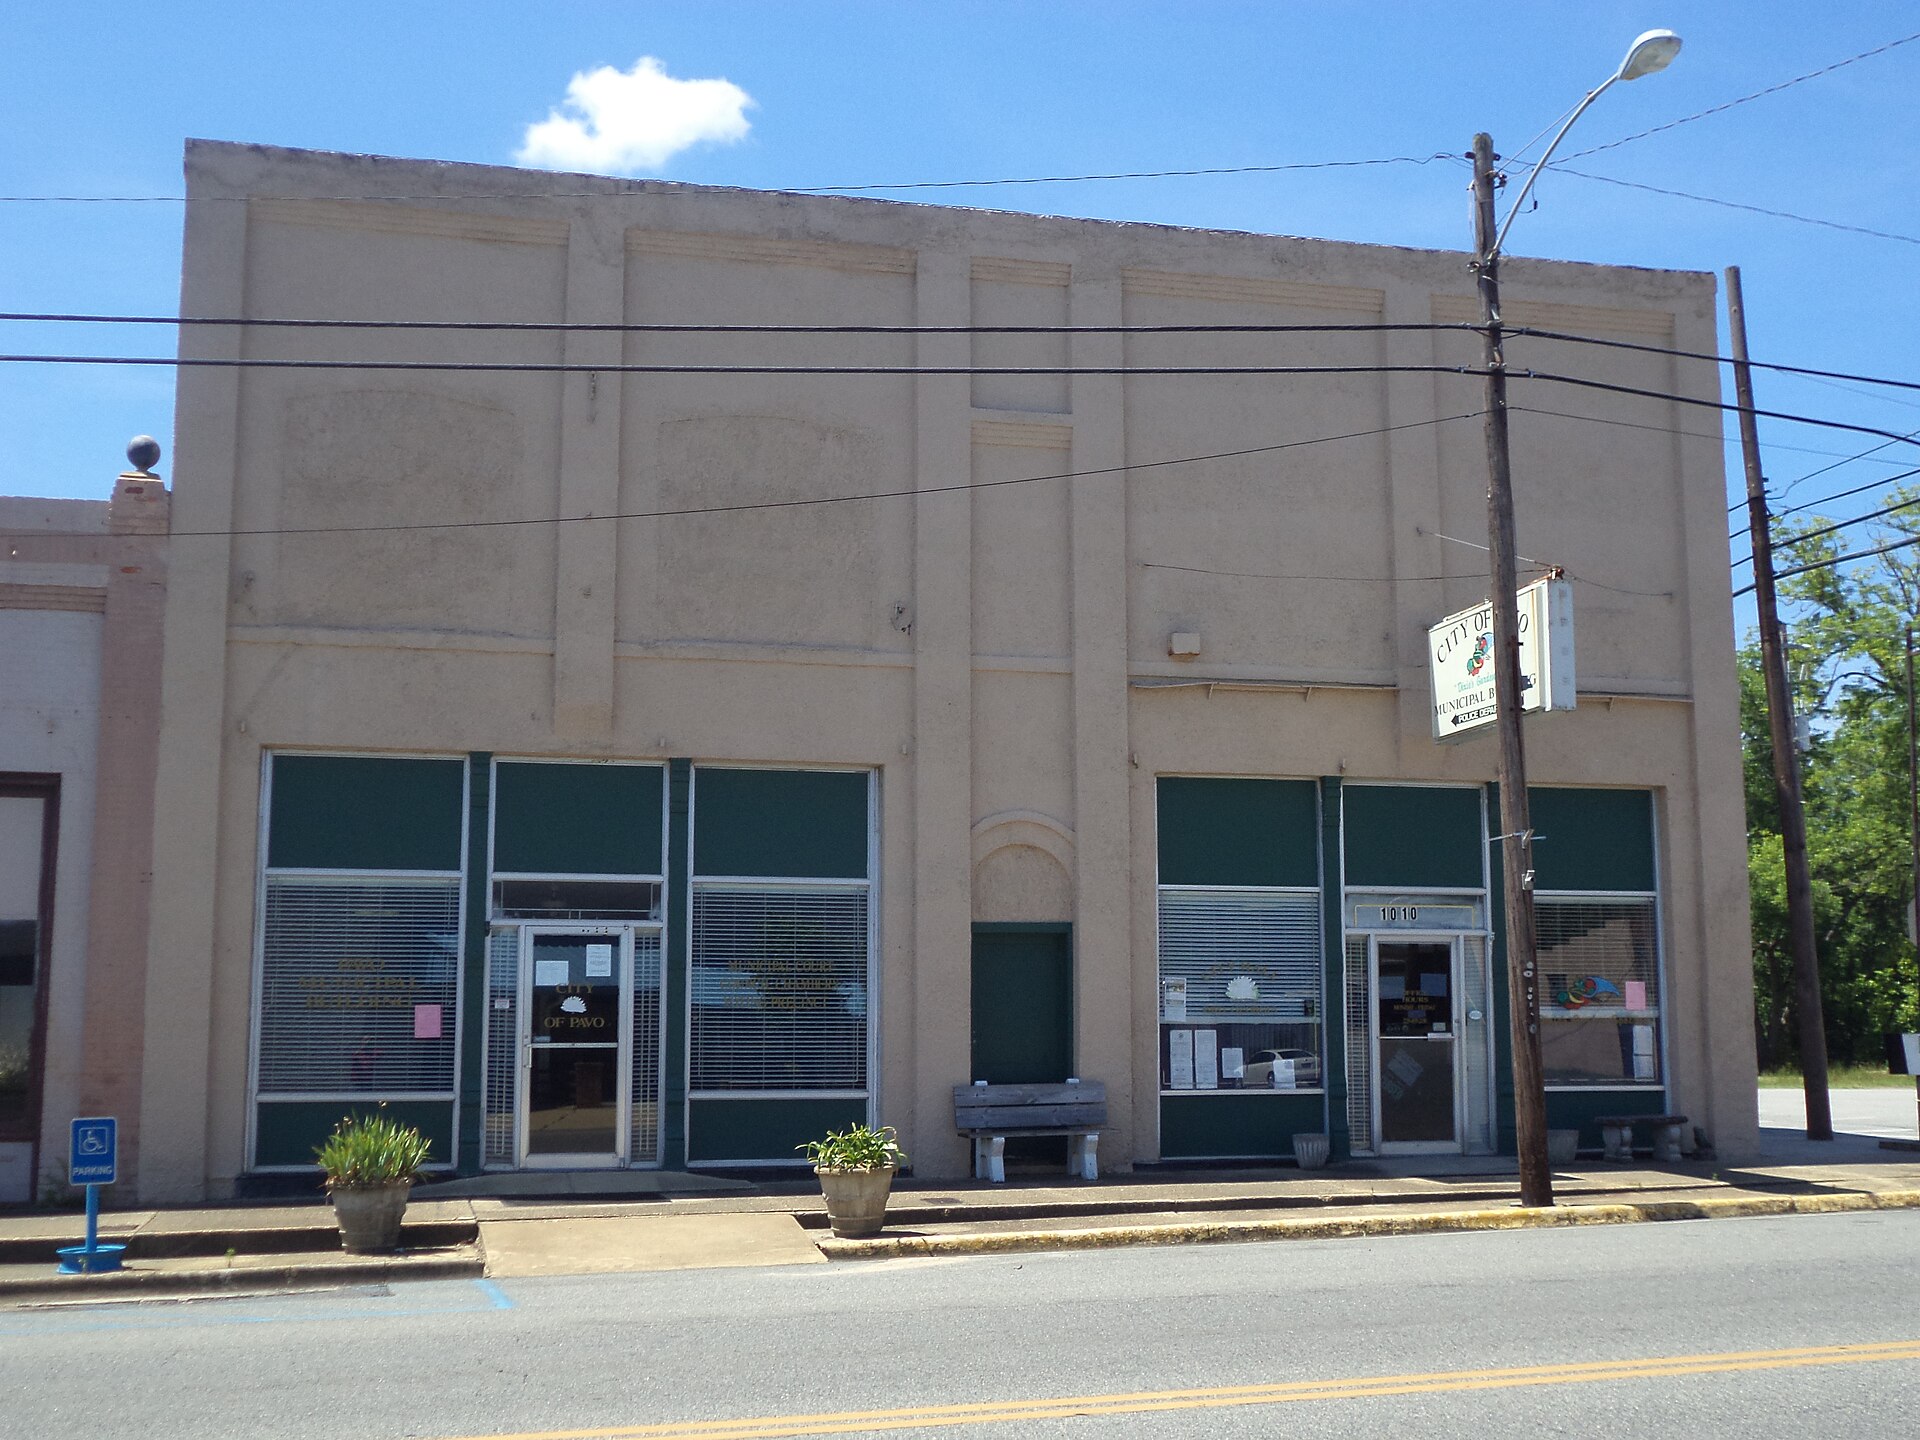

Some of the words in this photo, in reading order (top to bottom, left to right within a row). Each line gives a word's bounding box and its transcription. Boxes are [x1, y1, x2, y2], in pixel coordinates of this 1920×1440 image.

[1437, 619, 1468, 663] CITY
[1474, 609, 1491, 631] OF
[1435, 690, 1485, 717] MUNICIPAL
[1458, 710, 1479, 723] POLICE
[556, 983, 594, 994] CITY
[544, 1017, 565, 1028] OF
[569, 1017, 605, 1028] PAVO
[72, 1165, 112, 1176] PARKING
